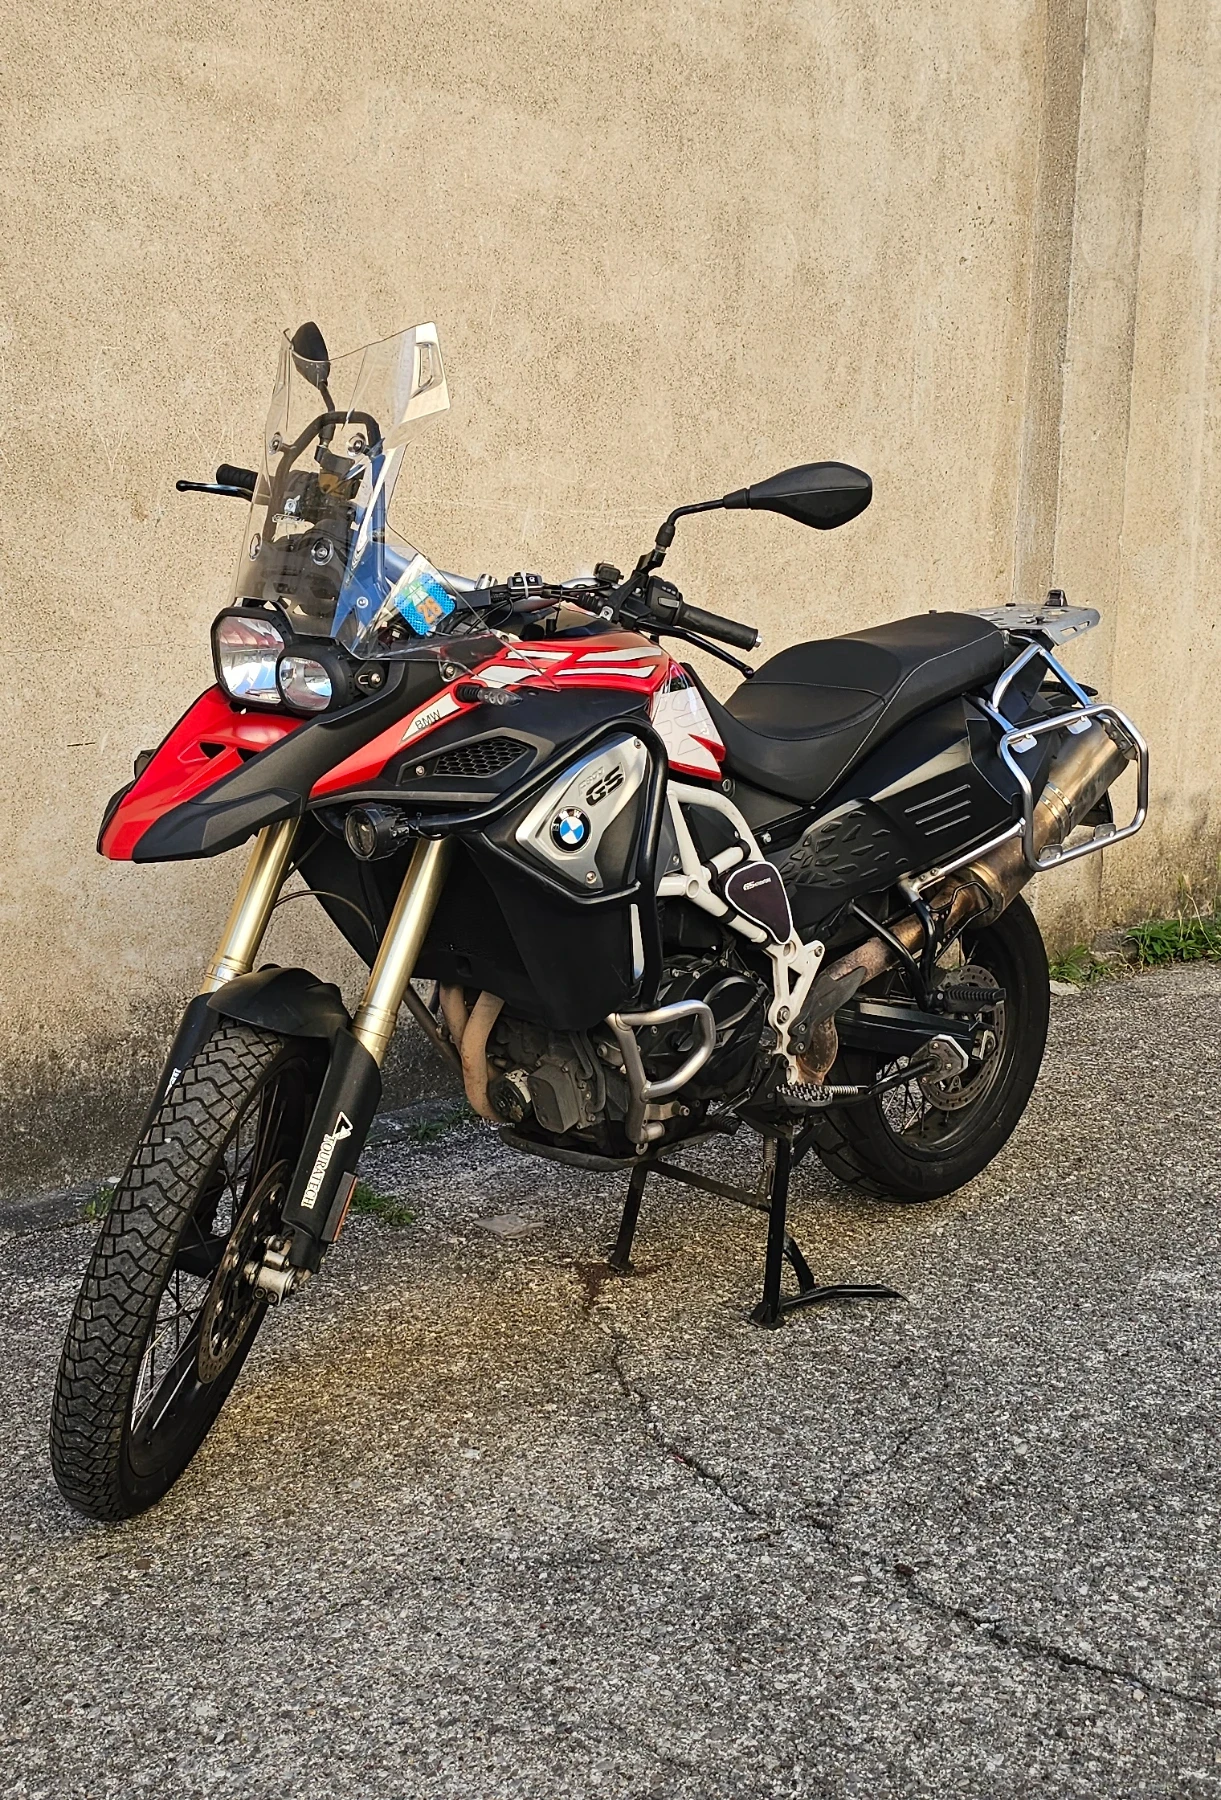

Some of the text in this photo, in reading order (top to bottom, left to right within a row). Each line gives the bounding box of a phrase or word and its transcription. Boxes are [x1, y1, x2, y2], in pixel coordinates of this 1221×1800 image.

[415, 709, 441, 730] BMW
[586, 765, 625, 806] GS
[551, 809, 582, 831] BMW
[301, 1134, 337, 1209] TOURATECH
